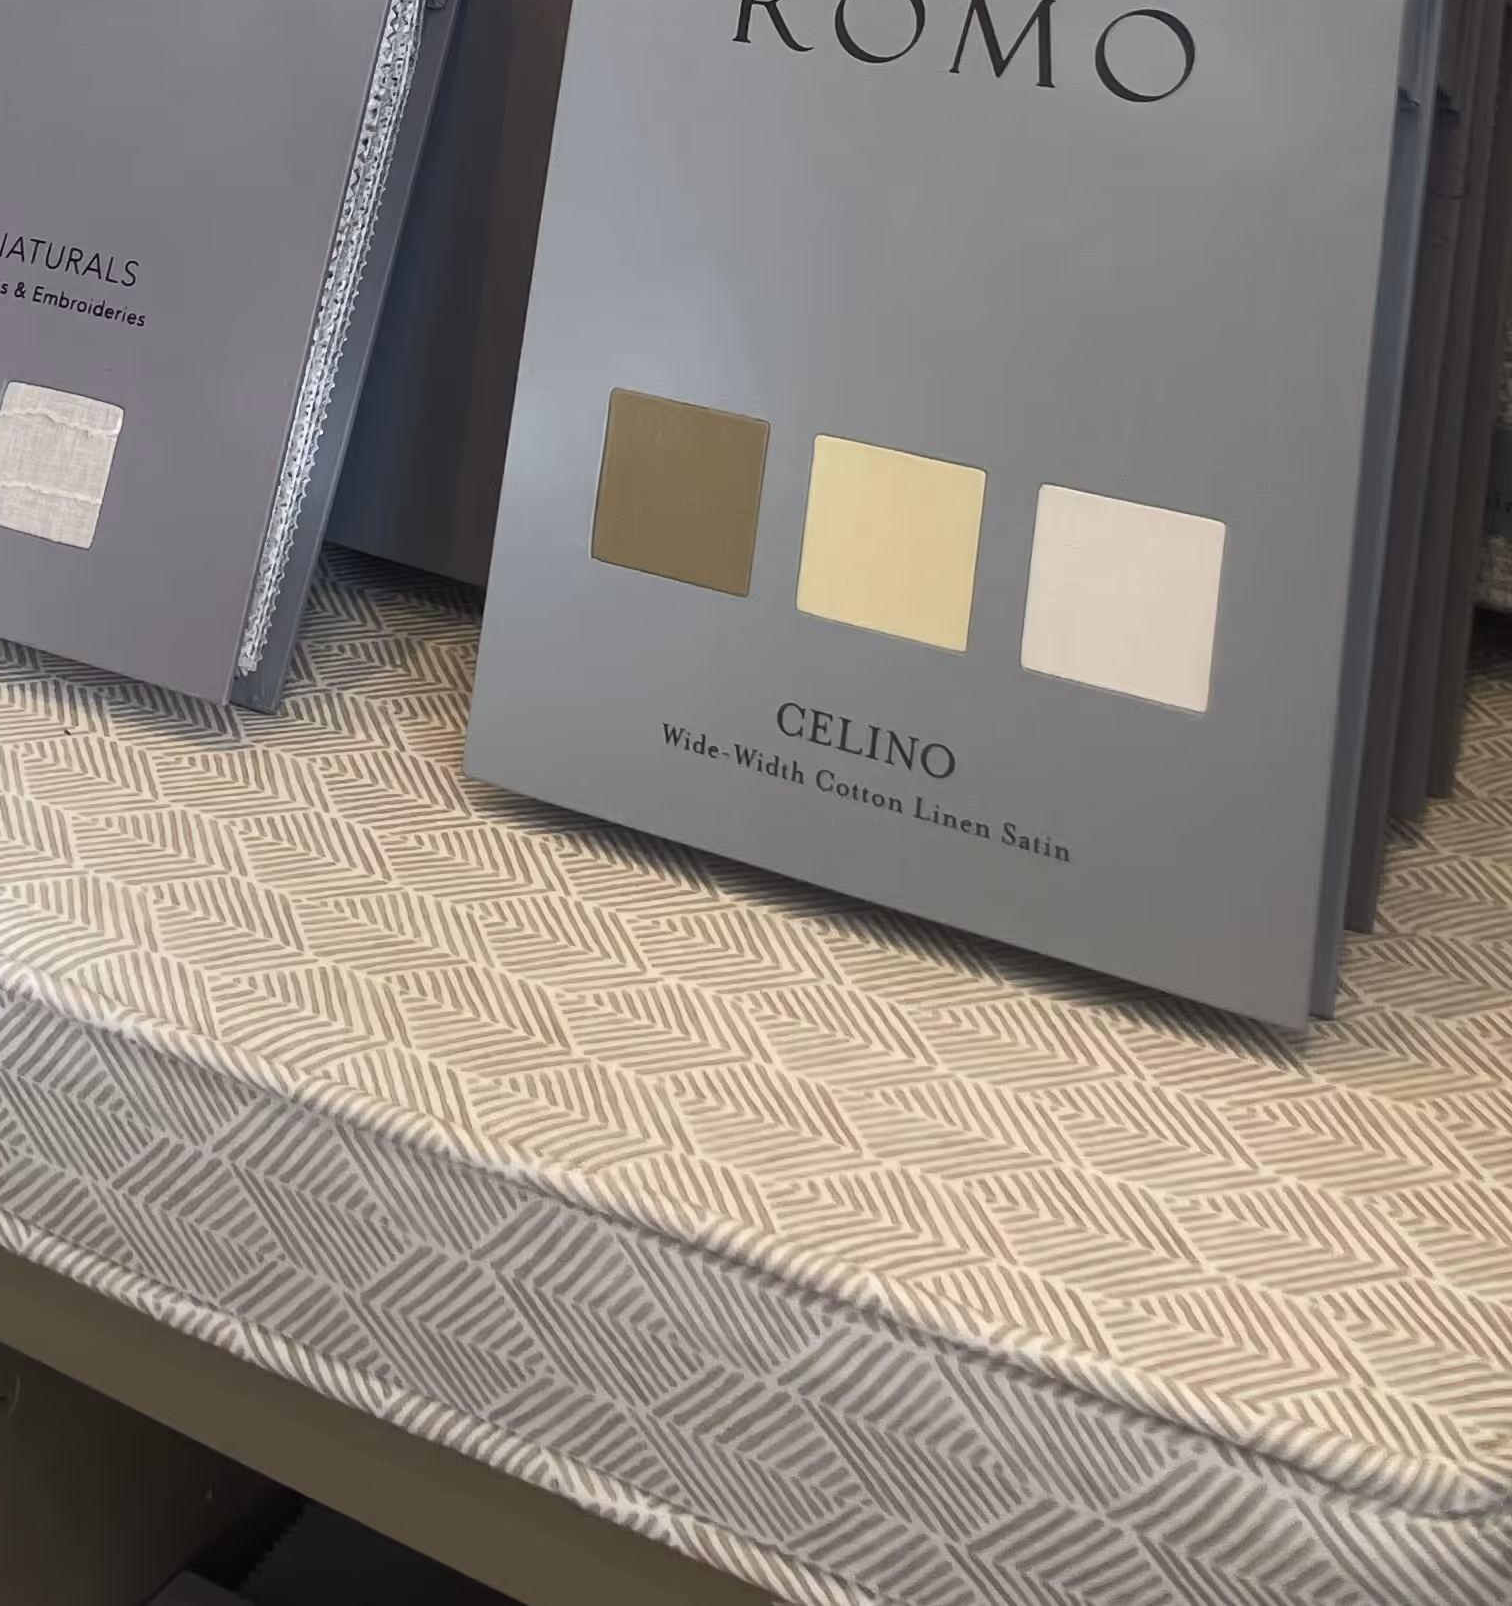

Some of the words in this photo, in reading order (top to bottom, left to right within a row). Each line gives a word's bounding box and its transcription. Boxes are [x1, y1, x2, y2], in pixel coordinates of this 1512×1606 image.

[13, 281, 26, 299] &
[31, 285, 146, 328] Embroideries
[776, 701, 956, 780] CELINO
[661, 722, 805, 785] Wide-Width
[815, 769, 904, 815] Cotton
[913, 796, 991, 840] Linen
[1000, 821, 1071, 863] Satin
